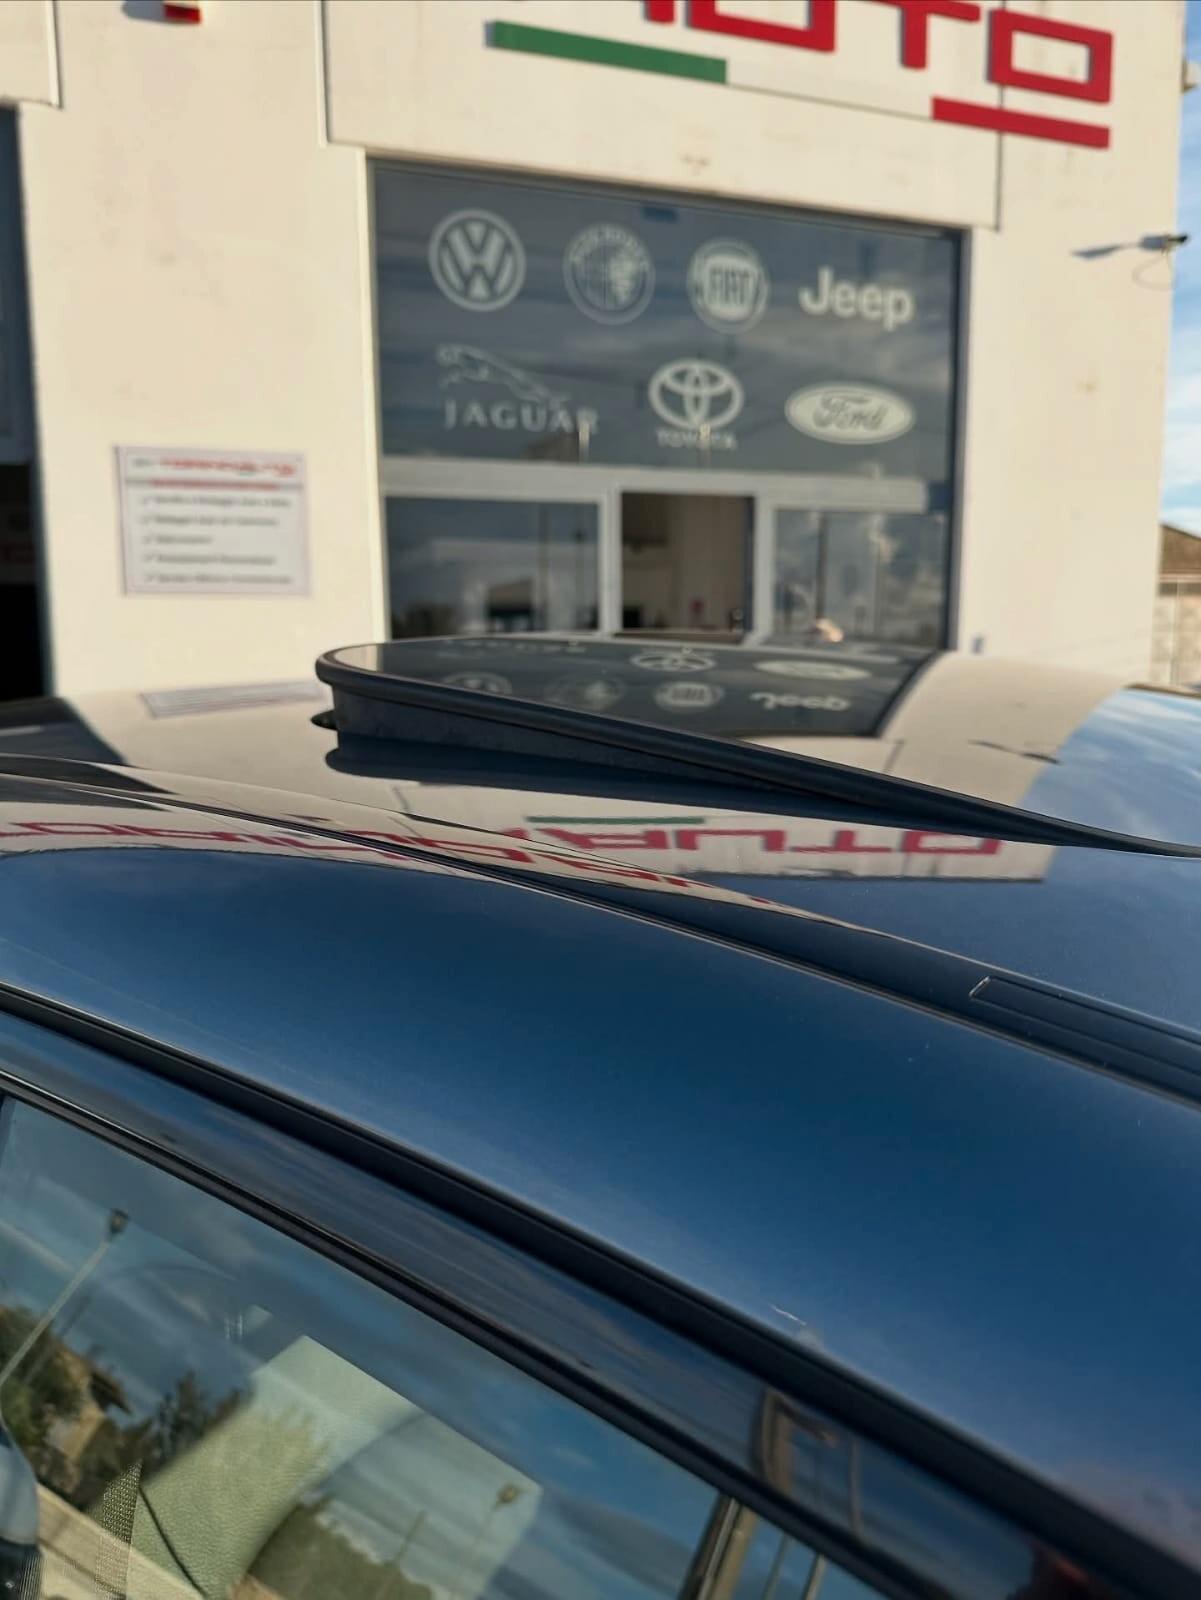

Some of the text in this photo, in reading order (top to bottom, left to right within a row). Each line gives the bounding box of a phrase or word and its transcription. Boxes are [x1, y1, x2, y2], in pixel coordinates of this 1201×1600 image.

[644, 0, 1113, 104] UTO
[799, 266, 915, 332] Jeep
[443, 398, 600, 434] JAGUAR
[811, 395, 890, 432] Ford
